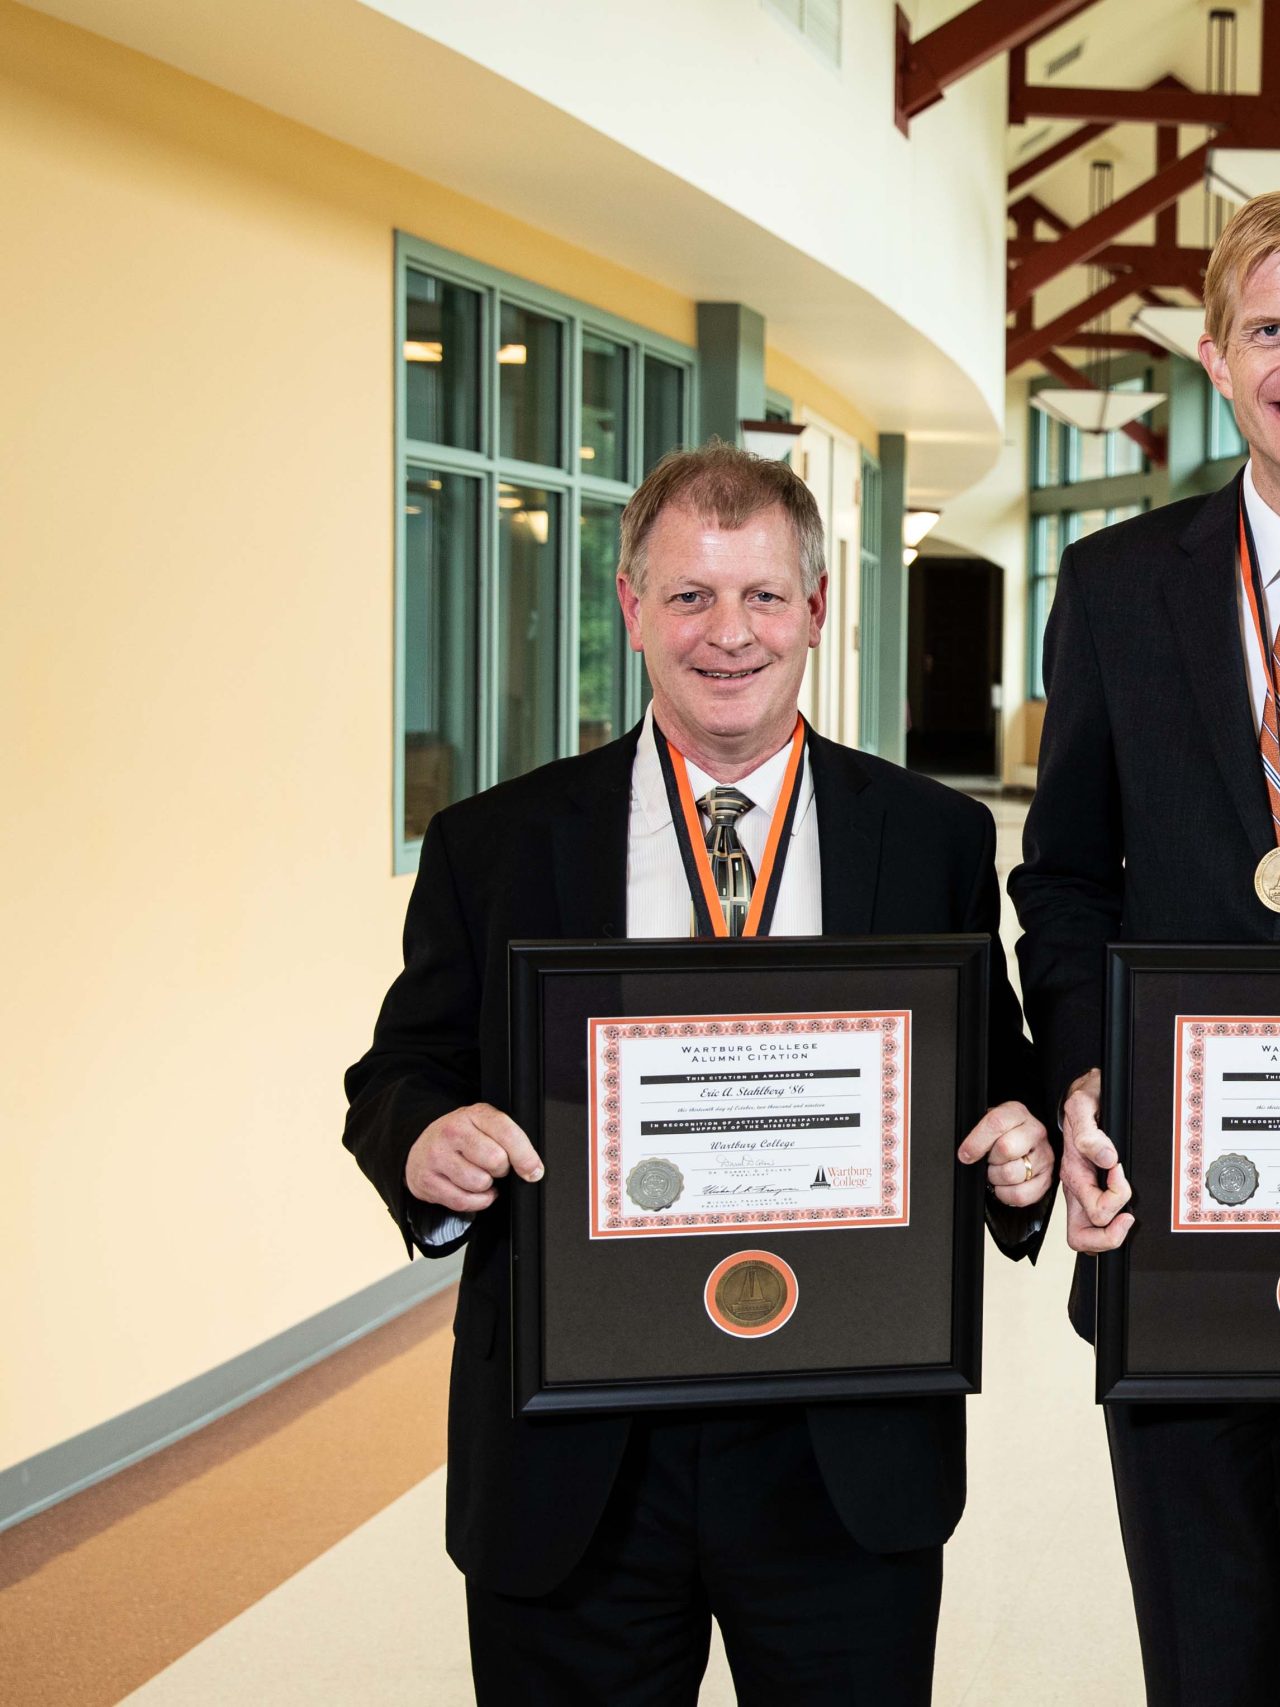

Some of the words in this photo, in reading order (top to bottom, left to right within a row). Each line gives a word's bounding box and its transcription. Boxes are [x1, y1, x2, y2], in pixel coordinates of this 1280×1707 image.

[682, 1045, 752, 1053] WARTBURG
[760, 1043, 818, 1051] COLLEGE
[691, 1054, 741, 1063] ALUMNI
[747, 1053, 808, 1061] CITATION
[700, 1087, 720, 1098] Eric
[736, 1085, 785, 1098] Stahlberg
[788, 1084, 805, 1094] '86
[710, 1140, 756, 1151] Wartburg
[760, 1139, 796, 1149] College
[827, 1165, 872, 1177] Wartburg
[832, 1176, 868, 1188] College
